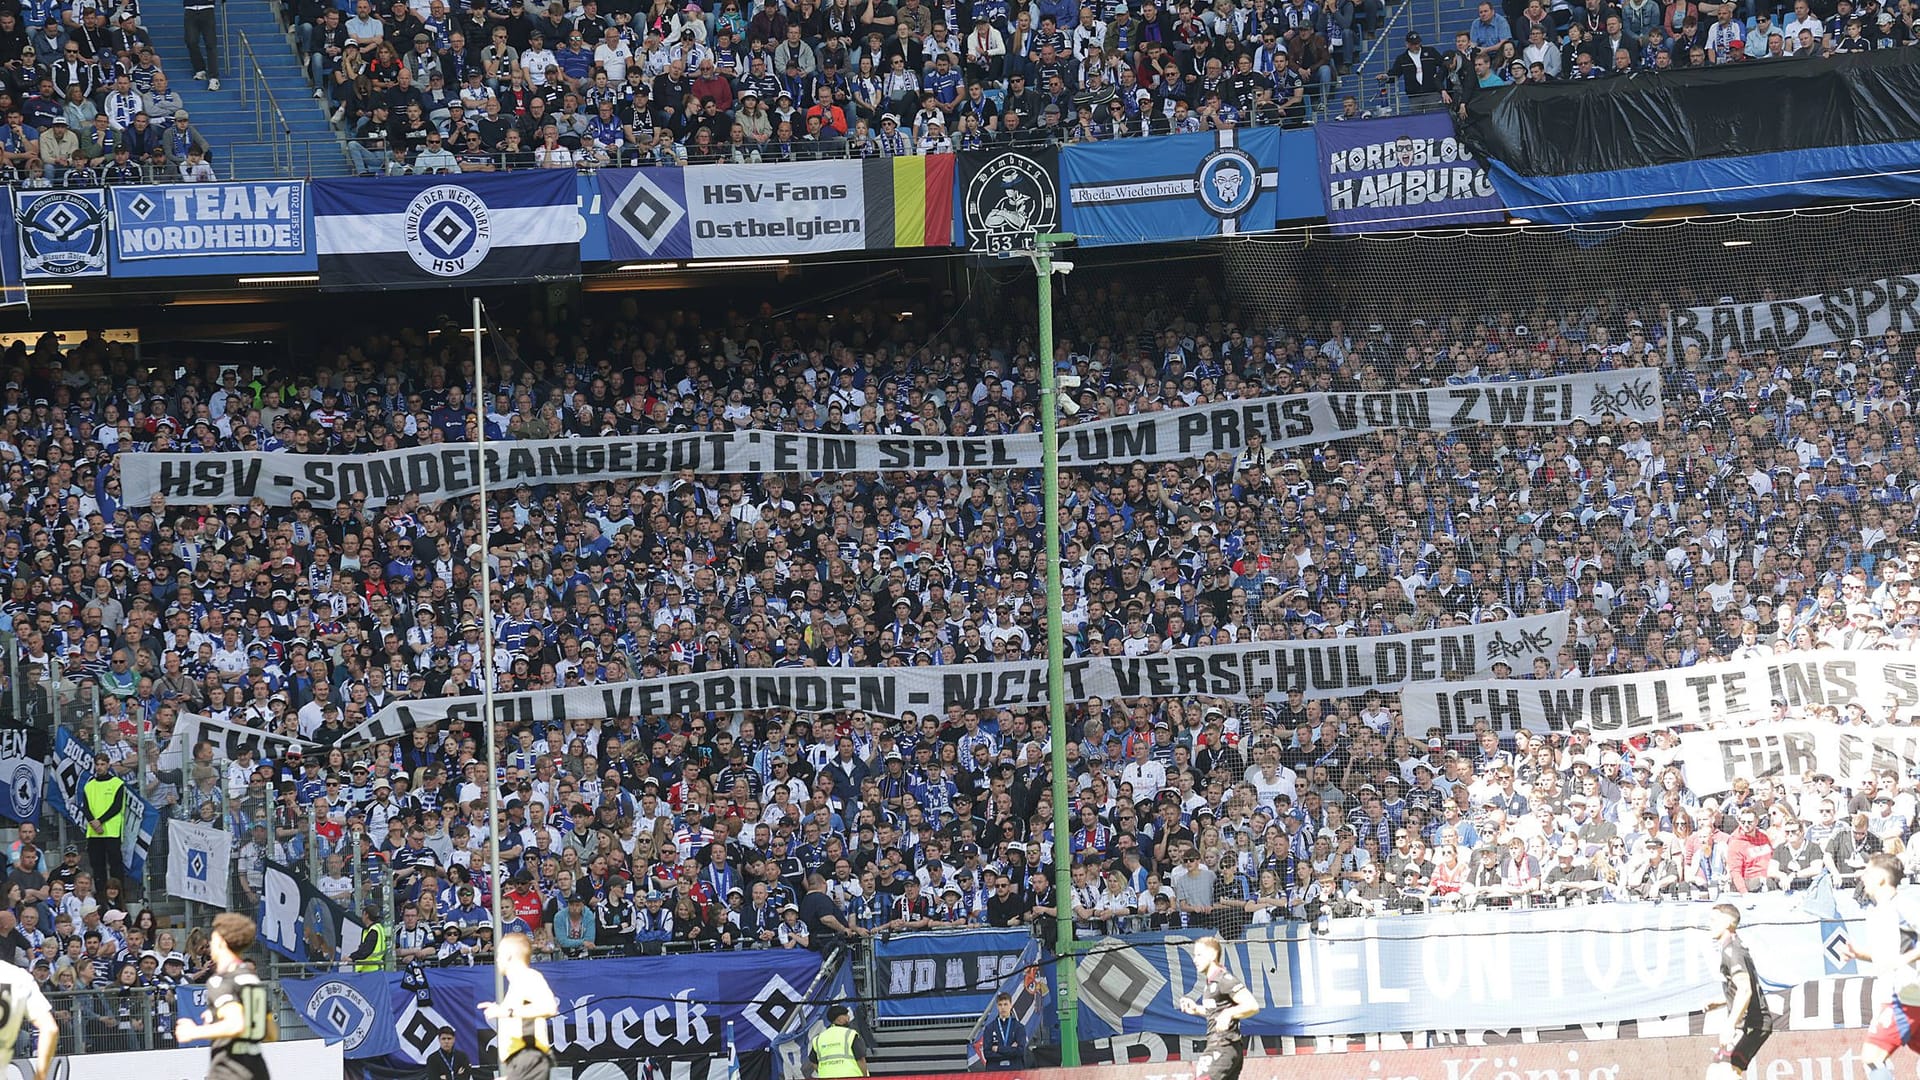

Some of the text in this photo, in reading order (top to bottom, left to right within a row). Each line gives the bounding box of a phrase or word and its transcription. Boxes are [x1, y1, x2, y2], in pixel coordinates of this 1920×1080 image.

[166, 186, 291, 222] TEAM
[291, 185, 300, 208] 2018
[703, 183, 847, 205] HSV-Fans
[1078, 182, 1187, 202] Rheda-Wiedenbrück
[1330, 168, 1495, 211] HAMBURG
[407, 189, 489, 242] KINDER DER WESTKURVE
[695, 217, 860, 241] Ostbelgien
[121, 223, 291, 252] NORDHEIDE
[433, 258, 465, 272] HSV
[160, 458, 262, 497] HSV
[774, 433, 857, 470] EIN
[878, 439, 1017, 468] SPIEL
[1179, 398, 1314, 453] PREIS
[1326, 391, 1434, 431] VON
[1448, 383, 1572, 426] ZWEI
[601, 675, 896, 717] VERBINDEN
[943, 661, 1090, 714] NICHT
[1110, 634, 1476, 697] VERSCHULDEN
[1434, 688, 1522, 736] ICH
[1539, 671, 1751, 733] WOLLTE
[1767, 659, 1859, 707] INS
[1718, 731, 1818, 783] FÜR
[486, 987, 713, 1053] beck
